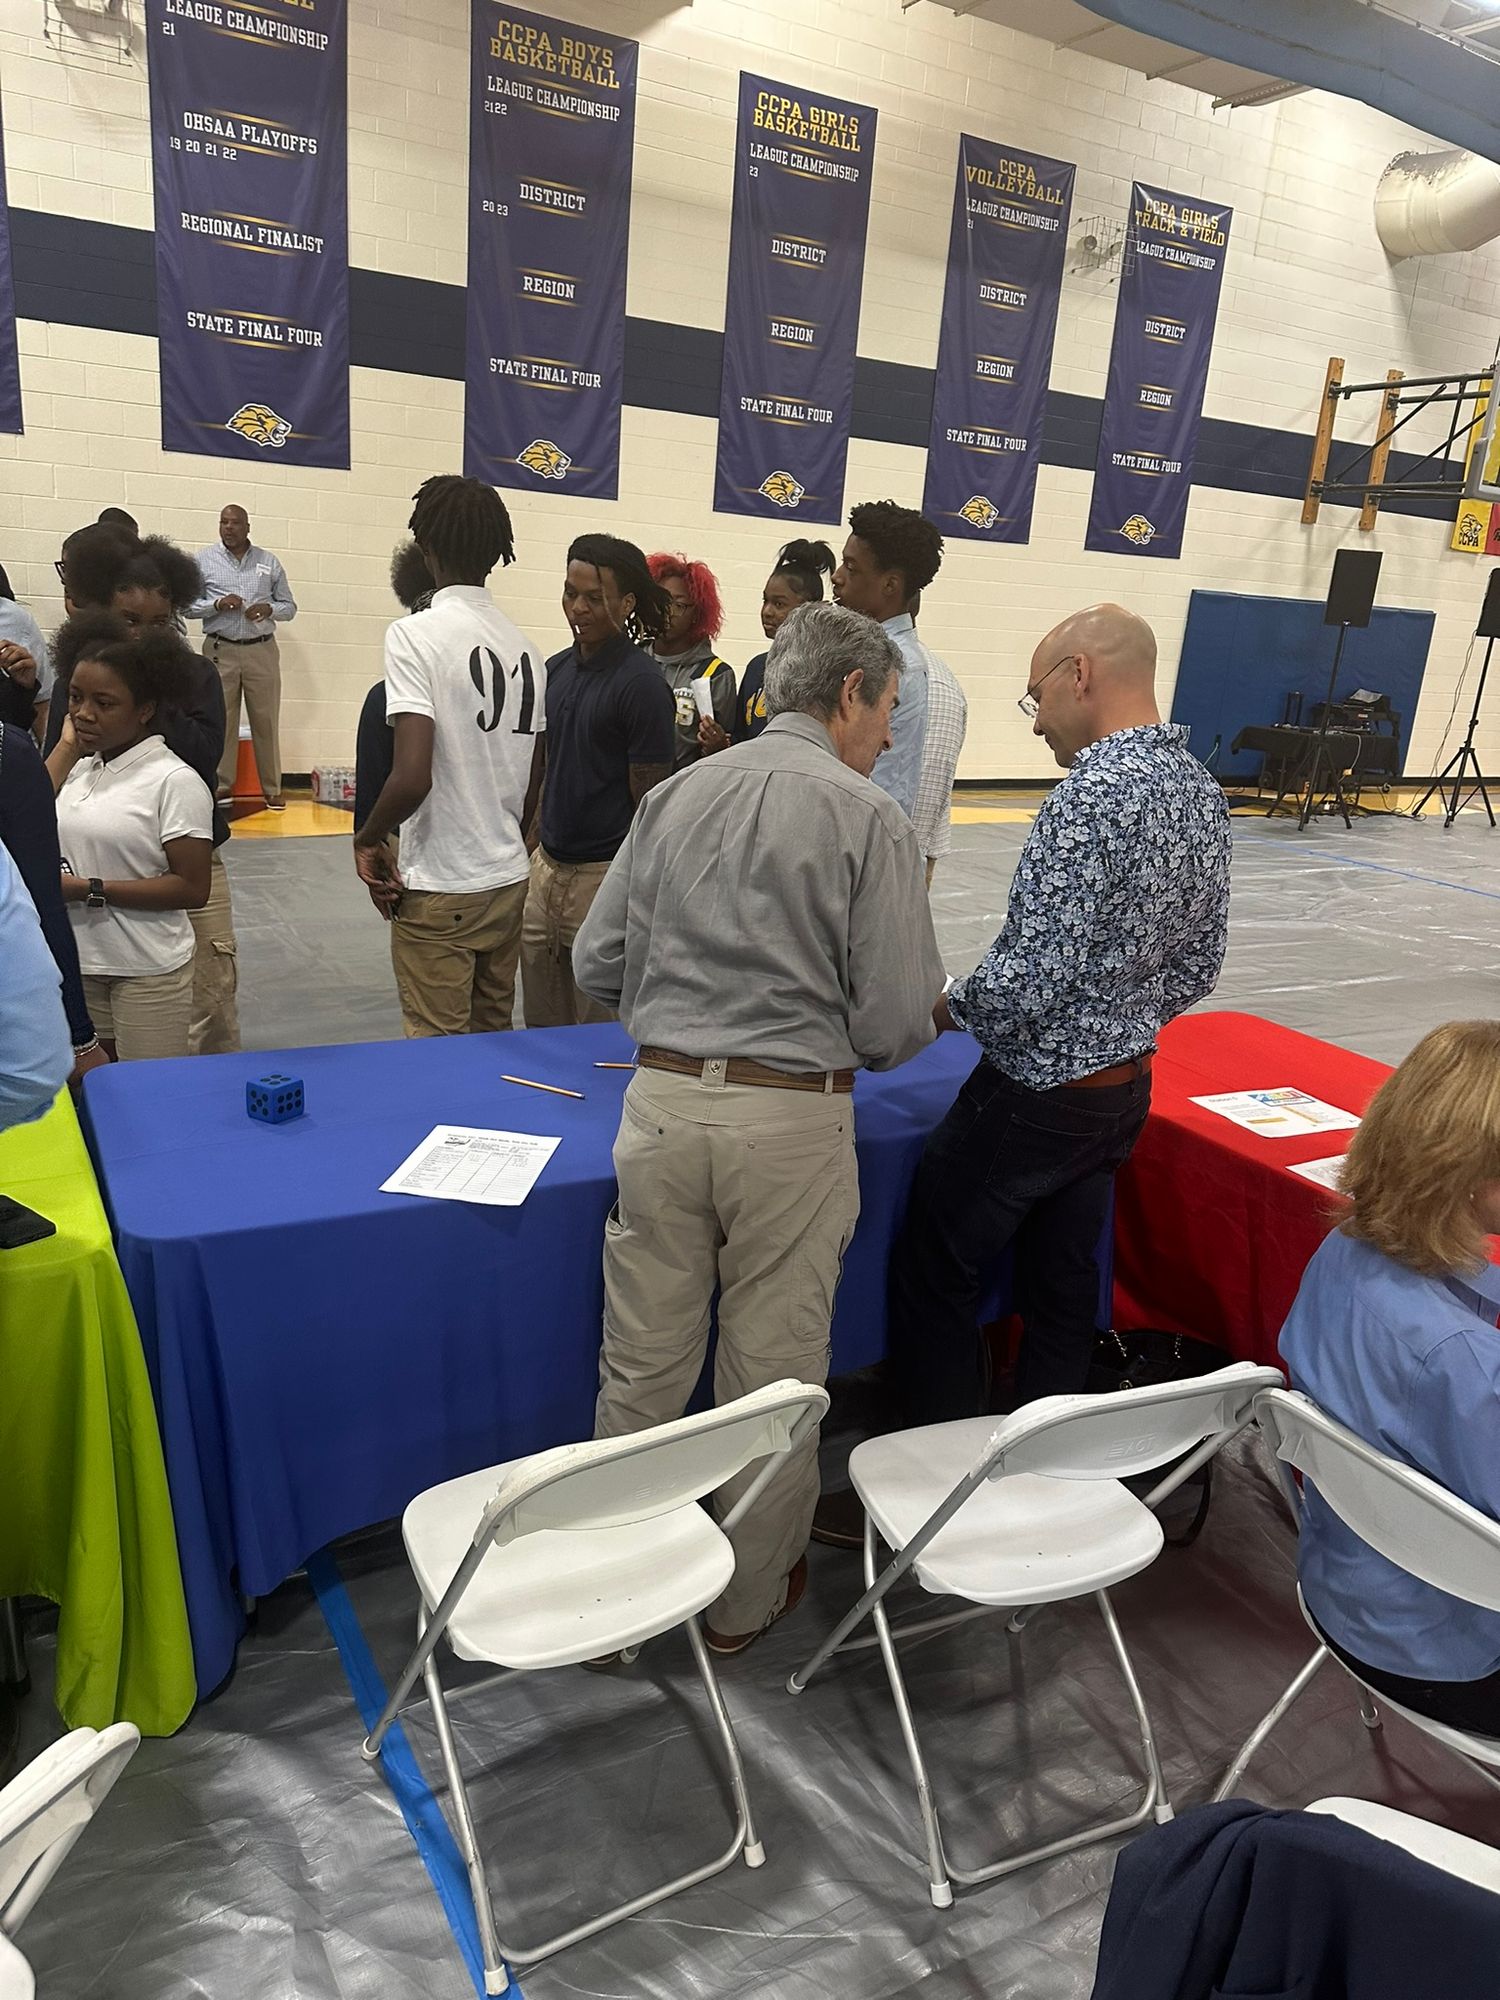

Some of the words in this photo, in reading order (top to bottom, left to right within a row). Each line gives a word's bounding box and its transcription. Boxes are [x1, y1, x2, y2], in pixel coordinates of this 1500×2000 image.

[162, 21, 175, 36] 21
[166, 0, 222, 26] LEAGUE
[227, 11, 328, 50] CHAMPIONSHIP
[498, 19, 552, 51] CCPA
[561, 36, 614, 68] BOYS
[490, 37, 620, 89] BASKETBALL
[487, 75, 533, 101] LEAGUE
[536, 88, 620, 122] CHAMPIONSHIP
[758, 91, 803, 119] CCPA
[809, 106, 859, 134] GIRLS
[184, 111, 236, 139] OHSAA
[241, 123, 317, 154] PLAYOFFS
[753, 108, 861, 152] BASKETBALL
[170, 136, 181, 150] 19
[185, 139, 200, 153] 20
[205, 143, 218, 157] 21
[222, 146, 237, 161] 22
[749, 142, 788, 166] LEAGUE
[790, 153, 859, 182] CHAMPIONSHIP
[749, 165, 759, 178] 23
[966, 165, 1064, 205] VOLLEYBALL
[999, 158, 1036, 182] CCPA
[482, 200, 495, 213] 20
[497, 203, 509, 217] 23
[519, 183, 586, 211] DISTRICT
[966, 197, 999, 218] LEAGUE
[999, 206, 1060, 232] CHAMPIONSHIP
[1135, 210, 1176, 234] TRACK
[1180, 223, 1188, 237] &
[1192, 226, 1225, 246] FIELD
[1145, 199, 1176, 220] CCPA
[1181, 208, 1219, 230] GIRLS
[181, 212, 253, 241] REGIONAL
[257, 227, 324, 254] FINALIST
[771, 239, 827, 264] DISTRICT
[1136, 240, 1165, 259] LEAGUE
[1165, 247, 1216, 270] CHAMPIONSHIP
[523, 275, 575, 299] REGION
[979, 284, 1027, 306] DISTRICT
[187, 311, 233, 334] STATE
[238, 319, 283, 341] FINAL
[287, 326, 323, 347] FOUR
[771, 322, 814, 343] REGION
[1145, 320, 1186, 339] DISTRICT
[489, 357, 528, 378] STATE
[531, 364, 568, 384] FINAL
[571, 370, 602, 388] FOUR
[976, 360, 1014, 379] REGION
[740, 396, 773, 415] STATE
[775, 402, 805, 420] FINAL
[806, 407, 833, 424] FOUR
[1140, 389, 1172, 406] REGION
[946, 428, 975, 445] STATE
[976, 432, 1002, 449] FINAL
[1004, 437, 1028, 452] FOUR
[1112, 453, 1136, 468] STATE
[1136, 455, 1160, 471] FINAL
[1161, 460, 1182, 473] FOUR
[469, 645, 535, 735] 91
